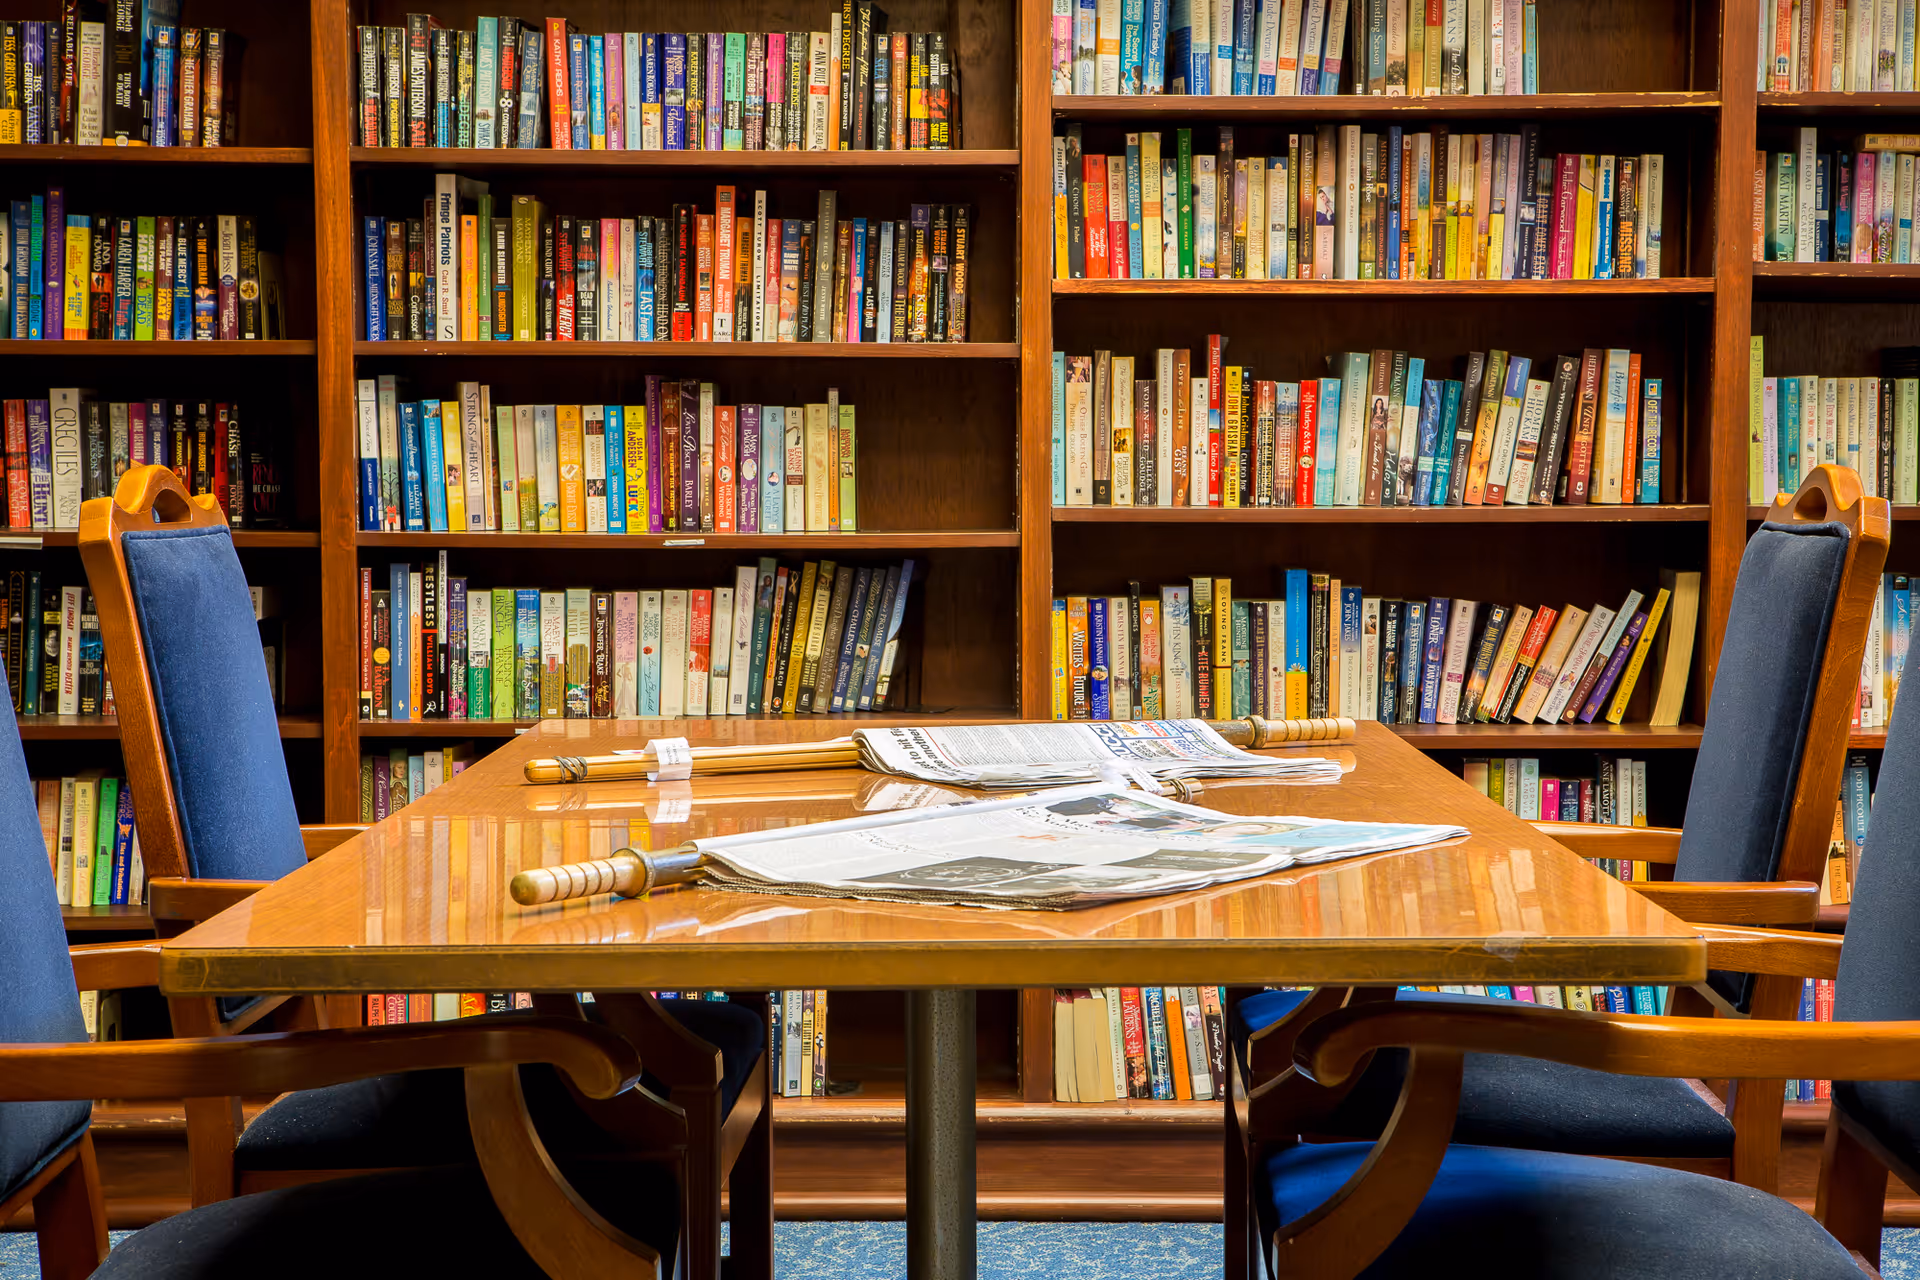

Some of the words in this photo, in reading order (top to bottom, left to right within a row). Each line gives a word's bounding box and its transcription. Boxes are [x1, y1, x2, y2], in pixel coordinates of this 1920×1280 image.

[1058, 17, 1067, 42] Family
[1125, 24, 1133, 57] Between
[1150, 22, 1161, 56] Delinsky
[411, 50, 425, 75] JAMES
[480, 46, 492, 68] JAMES
[553, 39, 562, 67] KATHY
[690, 51, 698, 75] KAREN
[815, 51, 826, 65] ANN
[842, 30, 851, 70] DEGREE
[1059, 43, 1067, 60] Tree
[1132, 37, 1140, 62] Secret
[1373, 35, 1382, 65] Season
[184, 59, 194, 94] HEATHER
[815, 68, 826, 84] RULE
[930, 54, 939, 85] SCOTTOLINE
[940, 63, 949, 75] LISA
[1125, 59, 1132, 69] Us
[24, 62, 32, 104] GERRITSEN
[33, 75, 42, 92] TESS
[411, 75, 425, 118] PATTERSON
[479, 70, 493, 105] PATTERSON
[555, 68, 564, 97] REICHS
[690, 77, 698, 97] ROSE
[184, 96, 194, 128] GRAHAM
[816, 101, 824, 116] WORTH
[501, 113, 510, 144] CONFESSION
[816, 118, 824, 131] MORE
[816, 132, 824, 144] DEAD
[930, 124, 939, 142] SMILE
[940, 122, 948, 143] KILLER
[1365, 147, 1374, 181] Hannah
[1379, 140, 1387, 180] MISSING
[1365, 184, 1373, 202] Rose
[1780, 172, 1790, 192] KAT
[440, 193, 451, 223] Fringe
[1780, 195, 1789, 235] MARTIN
[17, 228, 29, 245] JOHN
[222, 231, 234, 250] Joan
[497, 230, 505, 249] KARIN
[720, 207, 731, 247] MARGARET
[117, 237, 132, 264] KAREN
[138, 233, 149, 272] HART
[177, 238, 187, 257] BLUE
[440, 226, 451, 265] Patriots
[544, 239, 552, 256] BLIND
[639, 232, 647, 267] STEWART
[916, 230, 924, 259] STUART
[956, 228, 965, 260] STUART
[1618, 221, 1633, 273] MISSING
[17, 246, 29, 277] GRISHAM
[177, 258, 187, 284] MERCY
[223, 252, 234, 272] Hess
[497, 251, 506, 284] SLAUGHTER
[544, 258, 552, 278] CURVE
[720, 249, 731, 280] TRUMAN
[116, 266, 132, 297] HARPER
[915, 261, 923, 291] WOODS
[955, 263, 965, 294] WOODS
[16, 297, 29, 337] CONFESSION
[136, 295, 147, 325] DEAD
[640, 291, 652, 315] LAST
[895, 300, 905, 314] THE
[559, 307, 572, 338] MERCY
[640, 317, 650, 339] breath
[895, 315, 904, 338] BRIBE
[1585, 354, 1597, 399] HEITZMANN
[1753, 377, 1762, 394] FERN
[1228, 395, 1238, 415] JOHN
[1610, 371, 1624, 411] Barefoot
[1302, 404, 1312, 430] Marley
[1521, 397, 1534, 440] HICKAM
[1530, 399, 1544, 441] HOMER
[1648, 399, 1658, 413] OFF
[1753, 395, 1762, 425] MICHAELS
[54, 407, 78, 448] GREG
[1303, 431, 1311, 439] &
[1504, 416, 1515, 448] COUNTRY
[1648, 415, 1658, 428] THE
[627, 430, 637, 468] ANDERSEN
[743, 429, 751, 457] BALOGH
[1227, 420, 1238, 457] GRISHAM
[1303, 440, 1312, 453] Me
[1647, 429, 1658, 457] RECORD
[55, 450, 79, 476] ILES
[1498, 449, 1508, 476] DRIVING
[33, 483, 50, 525] HUNT
[627, 485, 638, 519] LUCKY
[685, 480, 693, 509] BARLEY
[66, 592, 76, 606] JEFF
[425, 567, 434, 627] RESTLESS
[67, 607, 75, 631] LINDSAY
[1344, 603, 1352, 621] JOHN
[596, 617, 605, 652] JENNIFER
[844, 609, 860, 656] CHALLENGE
[873, 613, 887, 647] PROMISE
[1344, 623, 1352, 641] JAKES
[1428, 617, 1440, 644] LONER
[1073, 630, 1085, 668] WRITERS
[1198, 651, 1209, 671] KITE
[596, 654, 605, 675] BLAKE
[777, 660, 786, 687] MARCH
[64, 672, 75, 695] DEXTER
[1074, 675, 1086, 705] FUTURE
[1199, 673, 1209, 709] RUNNER
[1122, 1000, 1136, 1038] LAURENS
[1149, 992, 1160, 1019] RACHEL
